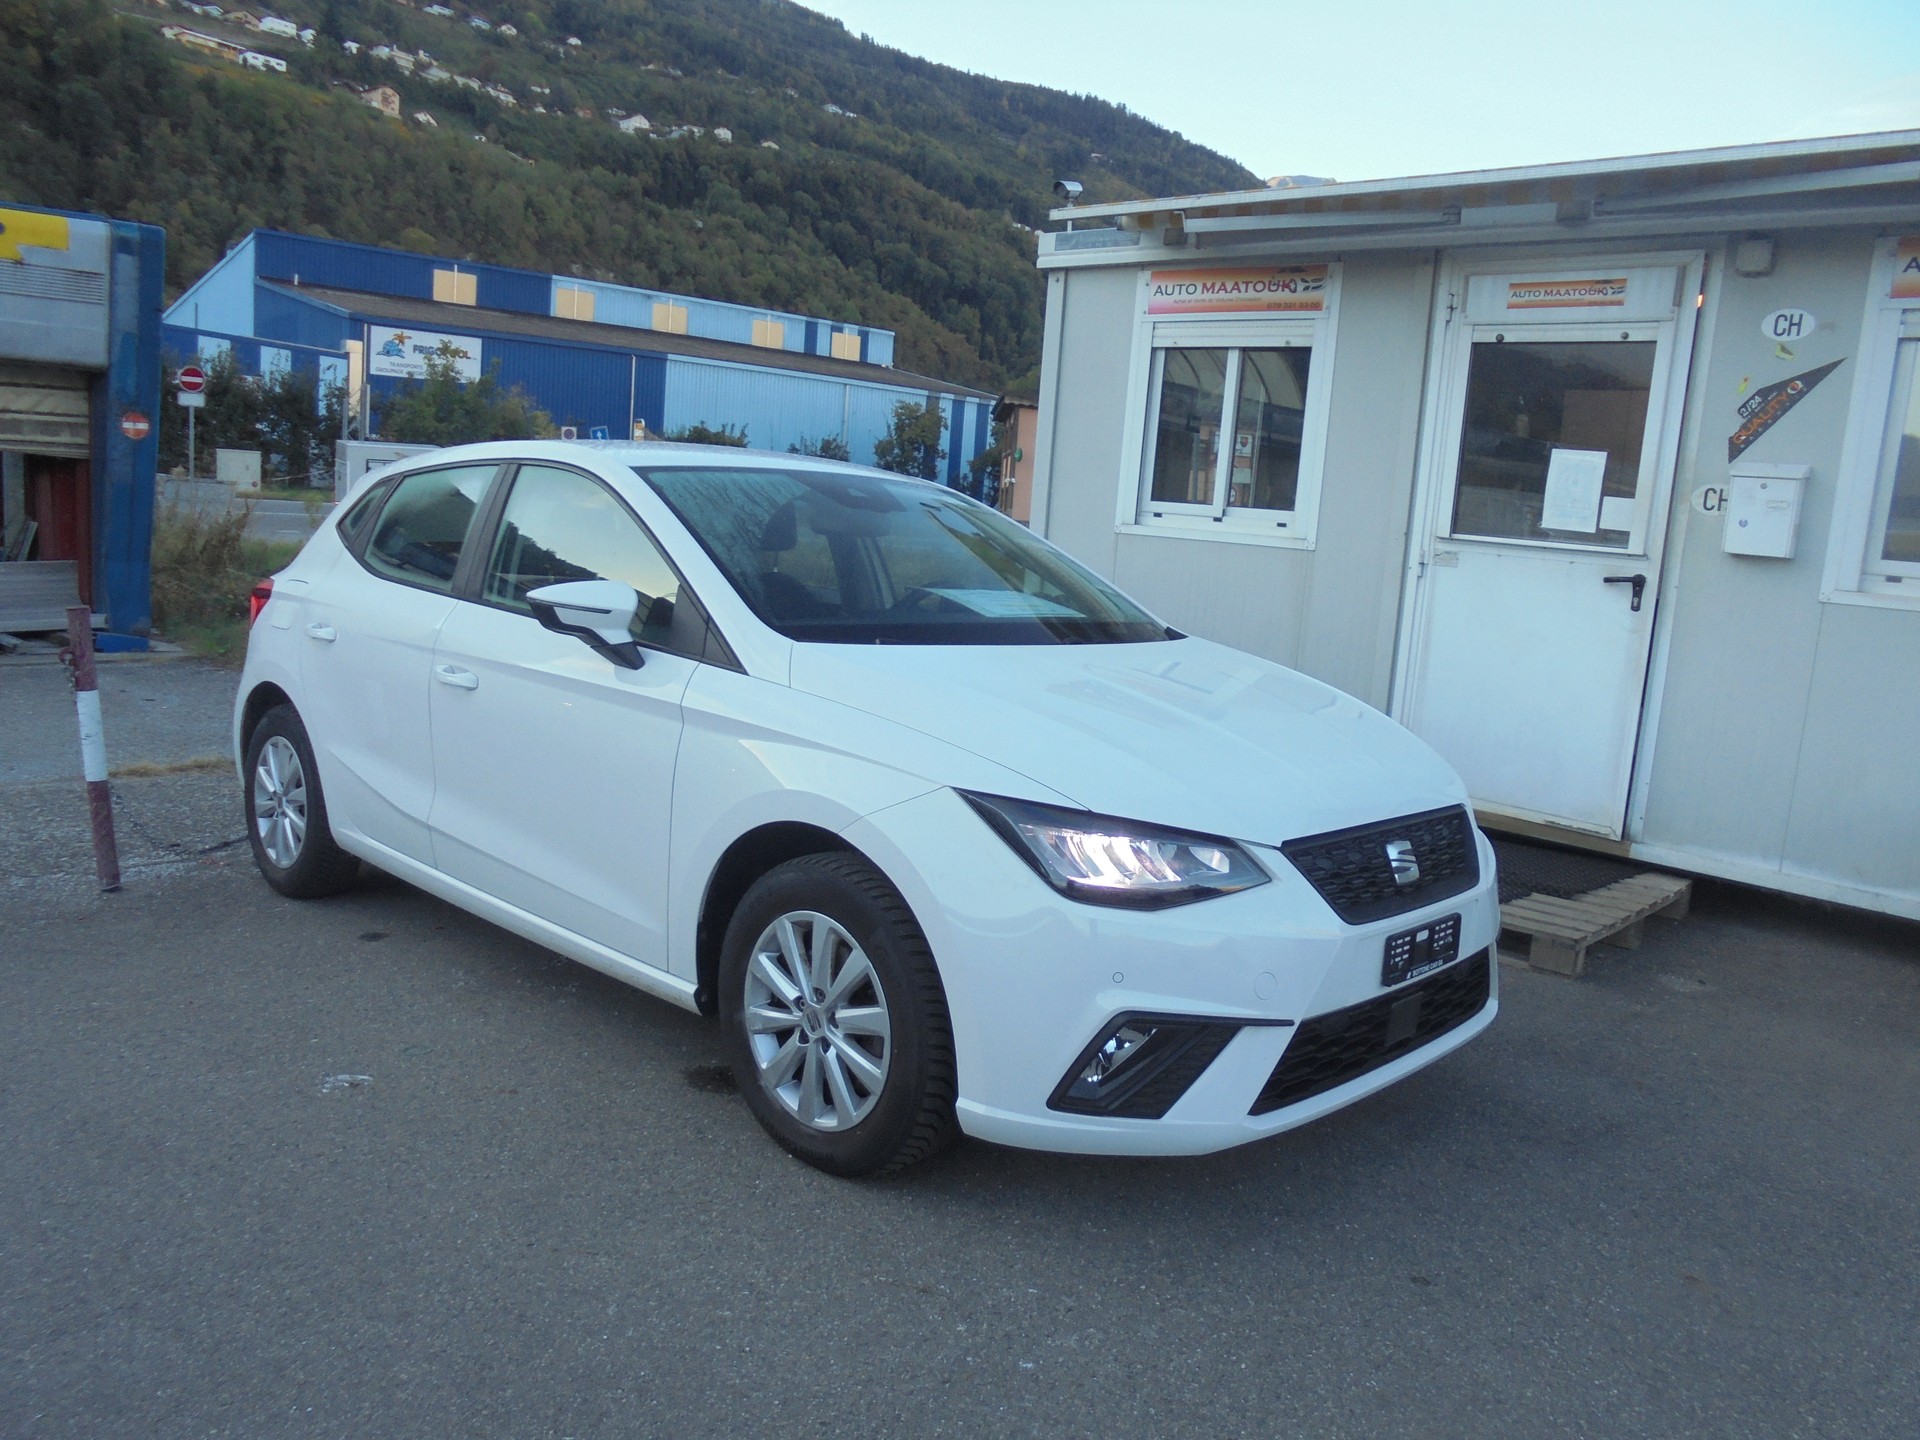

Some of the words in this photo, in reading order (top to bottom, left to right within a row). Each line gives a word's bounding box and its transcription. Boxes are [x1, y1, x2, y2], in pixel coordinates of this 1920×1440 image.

[1153, 283, 1198, 296] AUTO
[1200, 279, 1294, 295] MAATOUK
[1510, 289, 1542, 298] AUTO
[1543, 286, 1606, 298] MAATOUK
[1773, 313, 1803, 337] CH
[1740, 395, 1762, 417] 2/24
[1733, 391, 1789, 444] QUALITY
